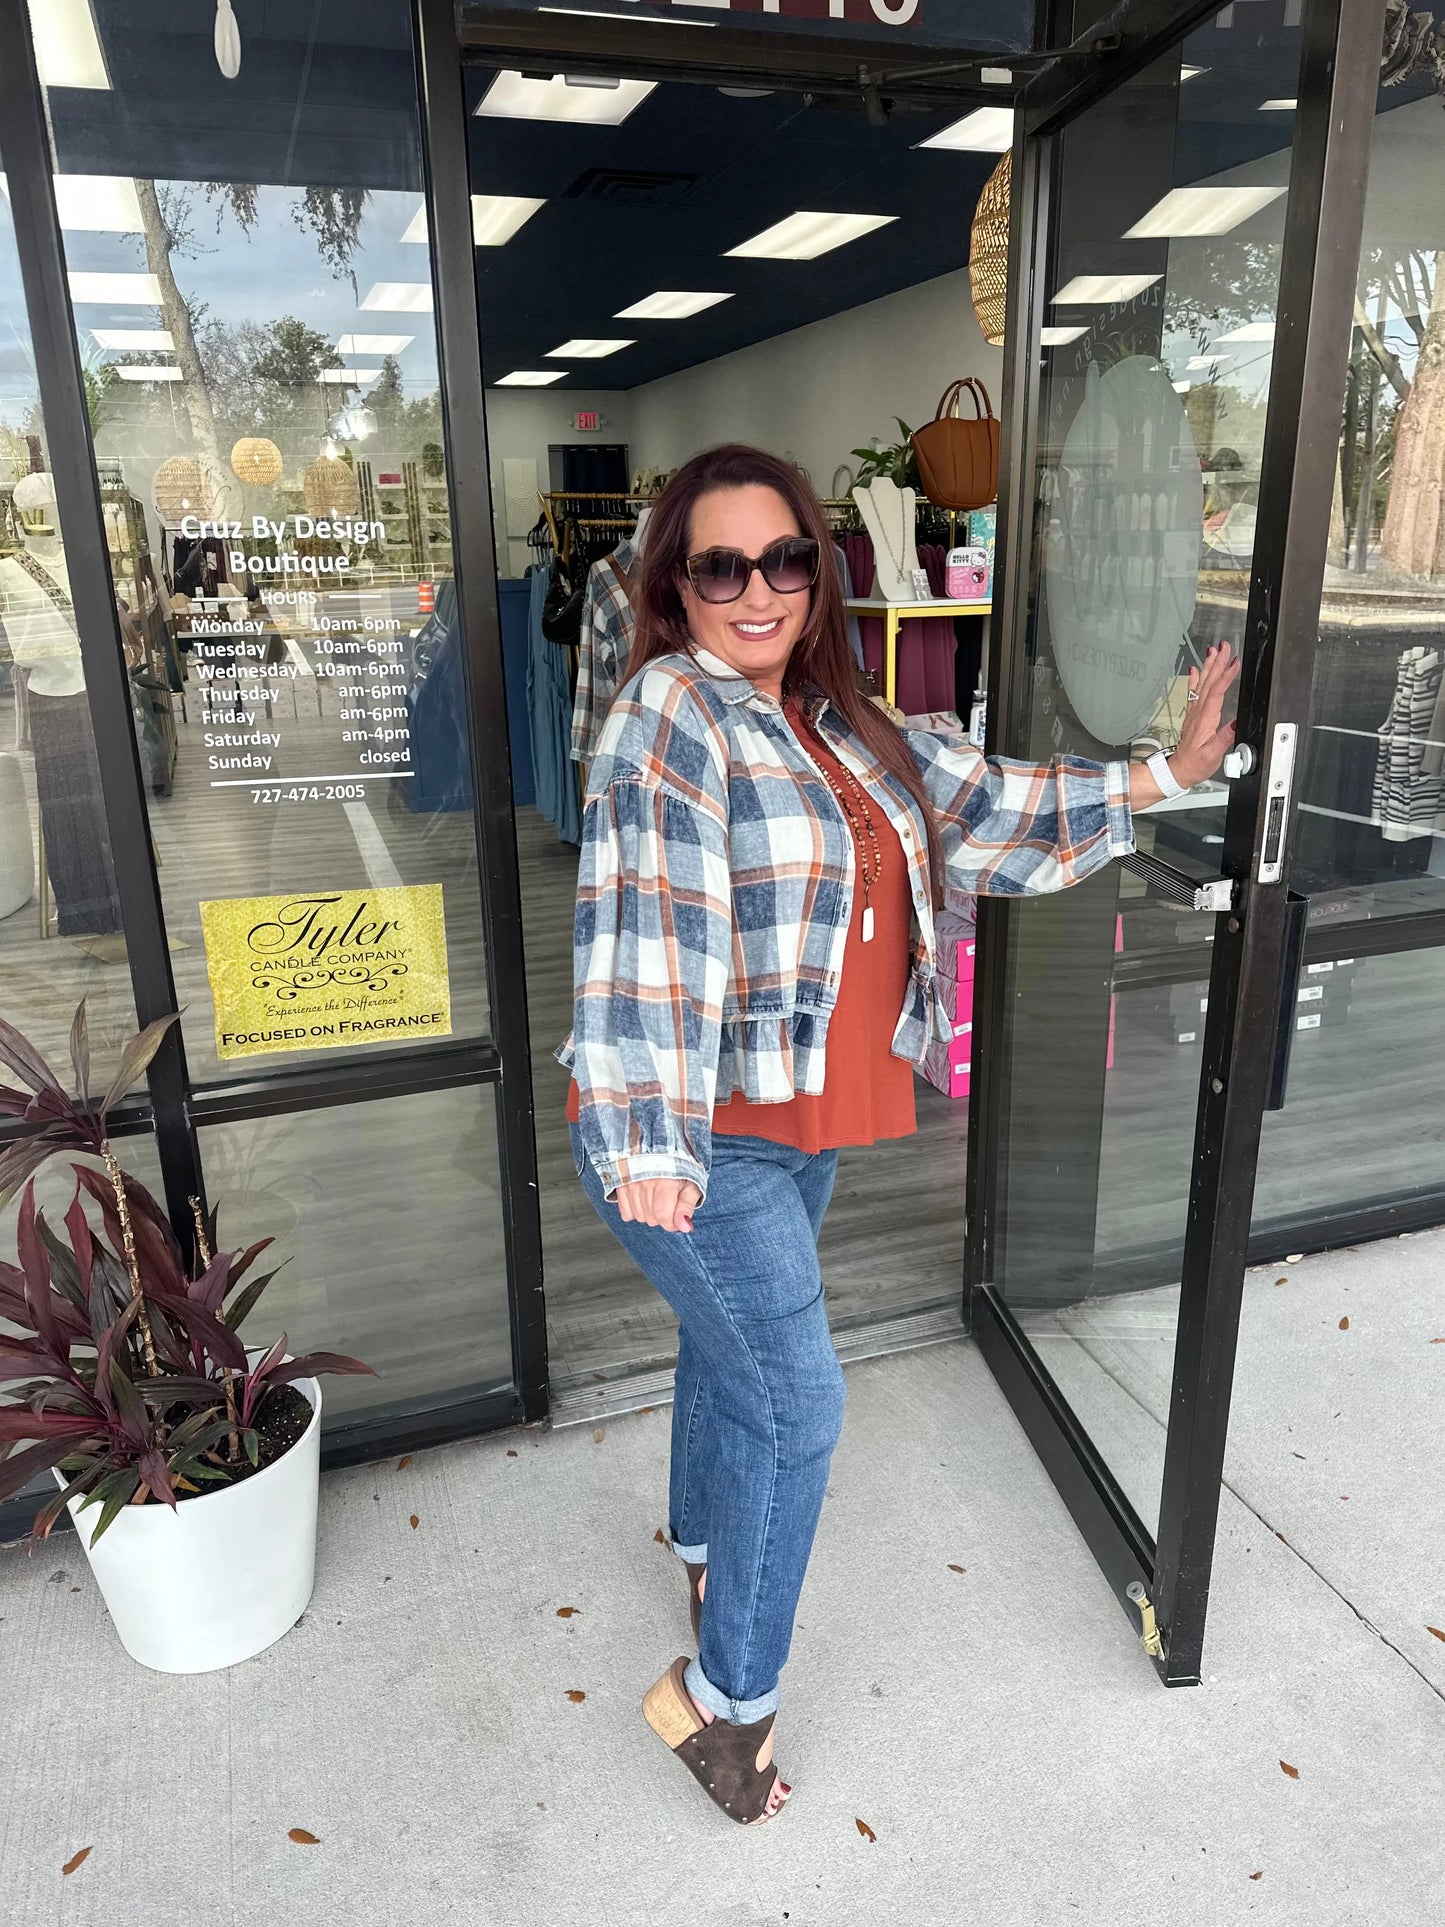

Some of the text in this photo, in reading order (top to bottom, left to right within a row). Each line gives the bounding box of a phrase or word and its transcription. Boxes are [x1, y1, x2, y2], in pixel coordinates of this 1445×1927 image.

[577, 412, 597, 429] EXIT
[180, 515, 386, 545] Cruz By Design
[229, 550, 350, 578] Boutique
[260, 590, 317, 605] HOURS
[191, 616, 401, 636] Monday 10am-6pm
[193, 639, 403, 659] Tuesday 10am-6pm
[196, 661, 405, 680] Wednesday 10am-6pm
[198, 683, 408, 703] Thursday am-6pm
[202, 706, 409, 727] Friday am-6pm
[204, 726, 410, 748] Saturday am-4pm
[208, 747, 411, 770] Sunday closed
[250, 784, 366, 804] 727-474-2005
[247, 896, 406, 957] Tyler
[250, 949, 407, 972] CANDLE COMPANY
[325, 999, 340, 1011] the
[222, 1013, 441, 1046] FOCUSED ON FRAGRANCE
